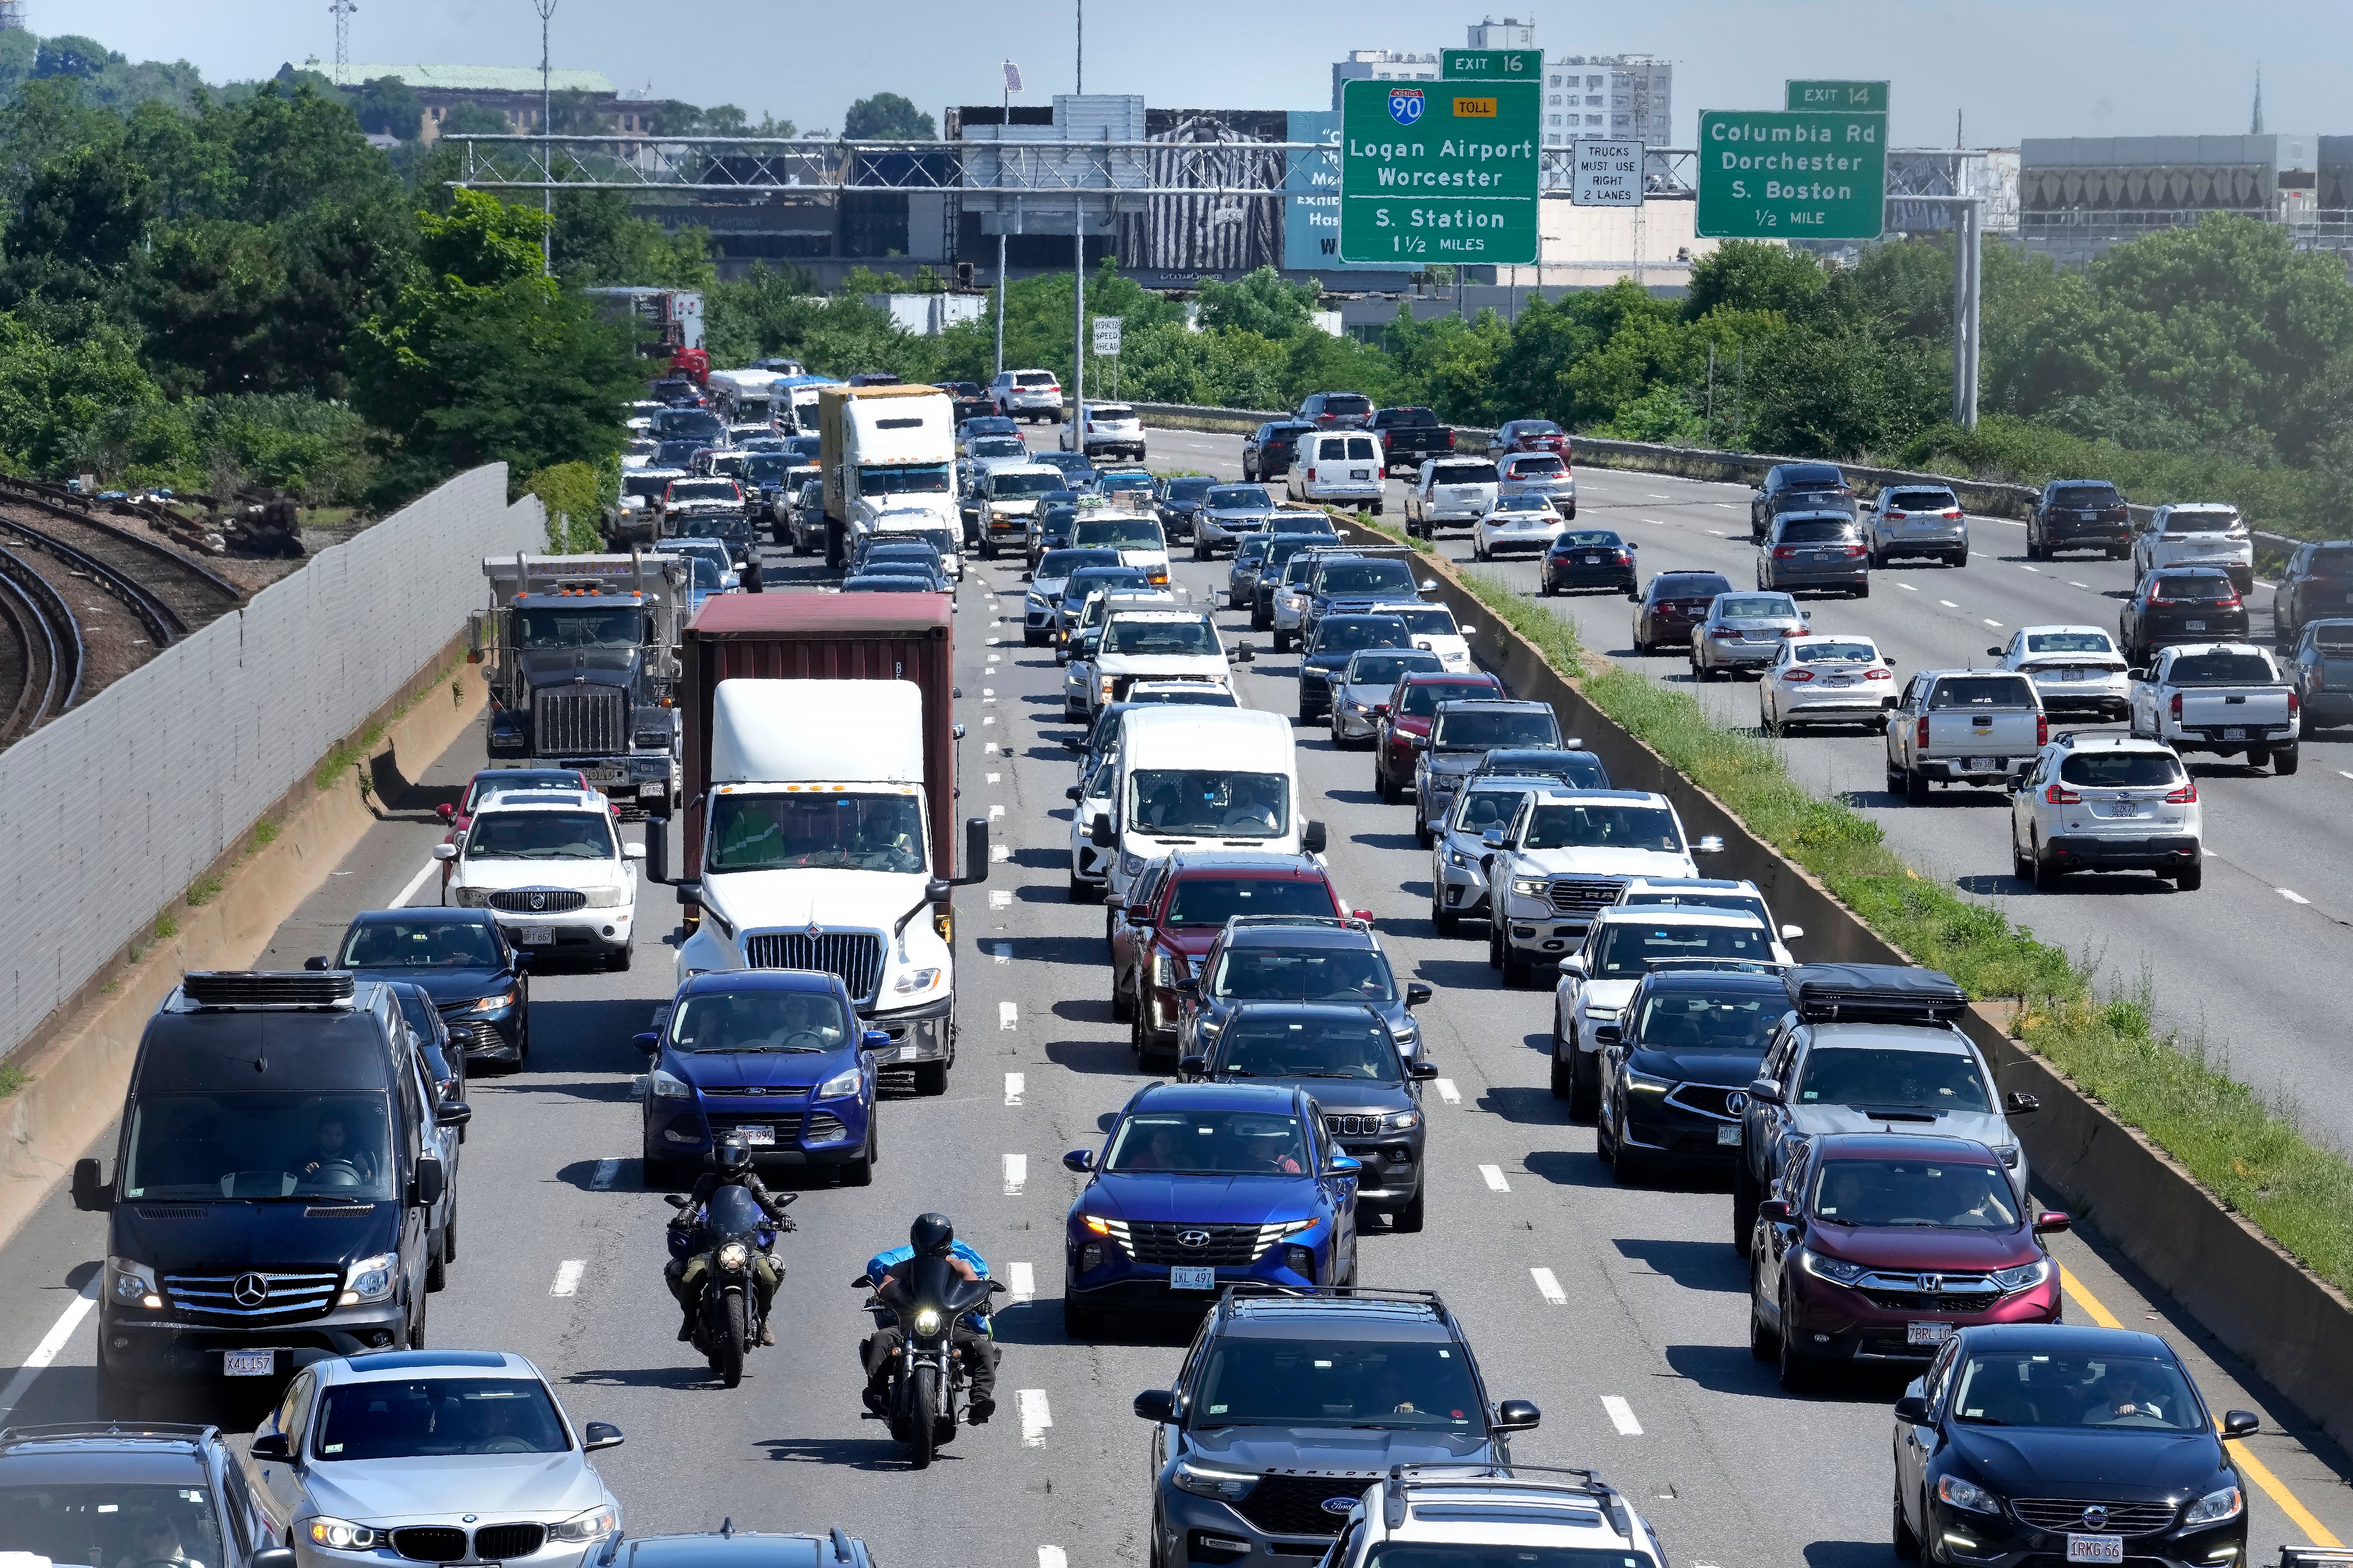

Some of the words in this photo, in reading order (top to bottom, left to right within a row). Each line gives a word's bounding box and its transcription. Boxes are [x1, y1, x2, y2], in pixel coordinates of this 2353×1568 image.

[1456, 58, 1488, 69] EXIT
[1503, 55, 1523, 71] 16
[1804, 89, 1838, 102] EXIT
[1848, 88, 1869, 104] 14
[1393, 98, 1421, 118] 90
[1459, 102, 1490, 113] TOLL
[1711, 123, 1832, 142] Columbia
[1846, 125, 1875, 143] Rd
[1350, 139, 1424, 162] Logan
[1439, 139, 1532, 161] Airport
[1589, 147, 1629, 156] TRUCKS
[1581, 162, 1609, 171] MUST
[1616, 162, 1636, 172] USE
[1722, 152, 1862, 171] Dorchester
[1377, 168, 1502, 186] Worcester
[1593, 177, 1623, 185] RIGHT
[1584, 190, 1591, 199] 2
[1598, 190, 1631, 200] LANES
[1731, 181, 1752, 198] S.
[1767, 181, 1851, 200] Boston
[1376, 208, 1396, 227] S.
[1410, 209, 1504, 228] Station
[1790, 212, 1826, 224] MILE
[1440, 239, 1484, 251] MILES
[1096, 332, 1118, 340] SPEED
[740, 1130, 754, 1141] NF
[756, 1130, 772, 1141] 999
[1174, 1272, 1189, 1283] 1KL
[1195, 1272, 1211, 1284] 497
[1909, 1328, 1935, 1339] 7BRL
[1938, 1328, 1950, 1339] 10
[1265, 1468, 1419, 1476] EXPLORR
[2071, 1542, 2094, 1556] 1RKG
[2105, 1543, 2120, 1556] 66
